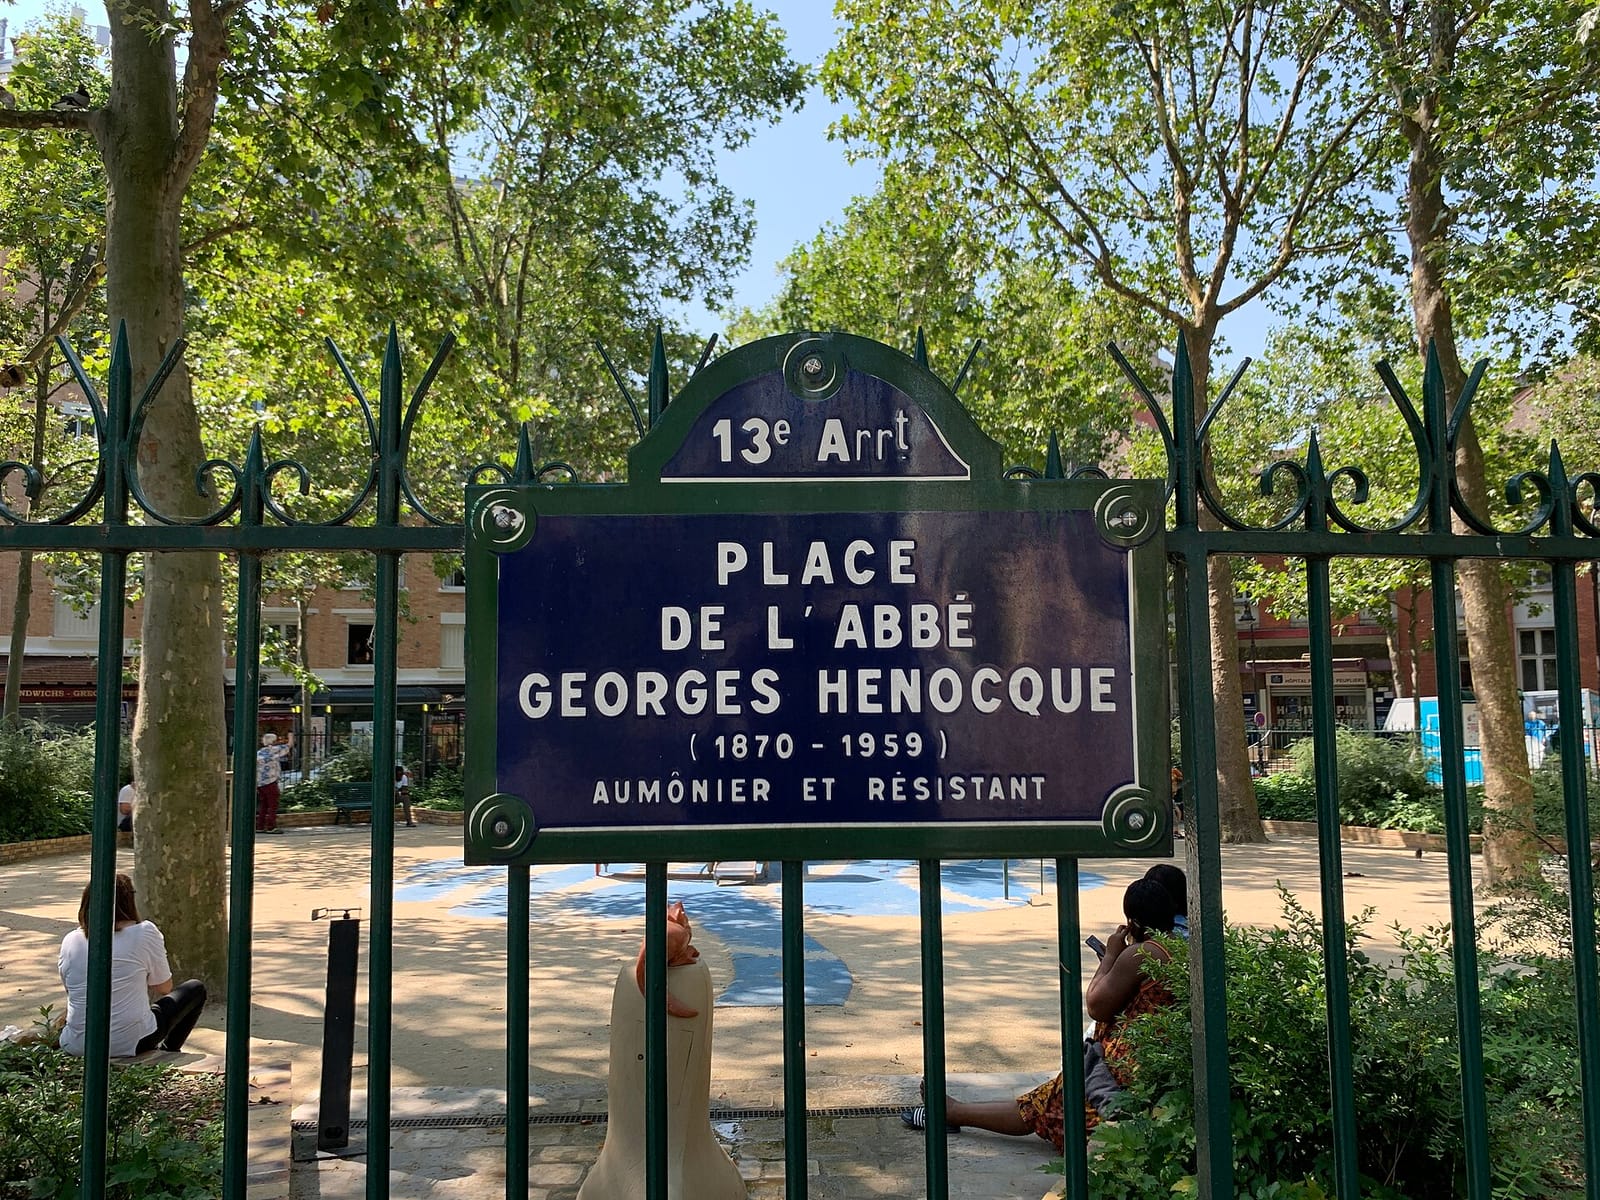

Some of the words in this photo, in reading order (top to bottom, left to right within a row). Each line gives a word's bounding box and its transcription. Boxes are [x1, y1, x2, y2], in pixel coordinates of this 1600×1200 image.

[712, 417, 791, 464] 13e
[817, 409, 909, 463] Arrt
[717, 539, 917, 586] PLACE
[661, 606, 725, 651] DE
[19, 689, 65, 697] NDWICHS
[518, 669, 781, 719] GEORGES
[818, 666, 1117, 718] HENOCQUE
[1336, 705, 1367, 715] PRIV
[592, 771, 770, 804] AUMÔNIER
[803, 777, 835, 802] ET
[868, 773, 1046, 801] RÉSISTANT
